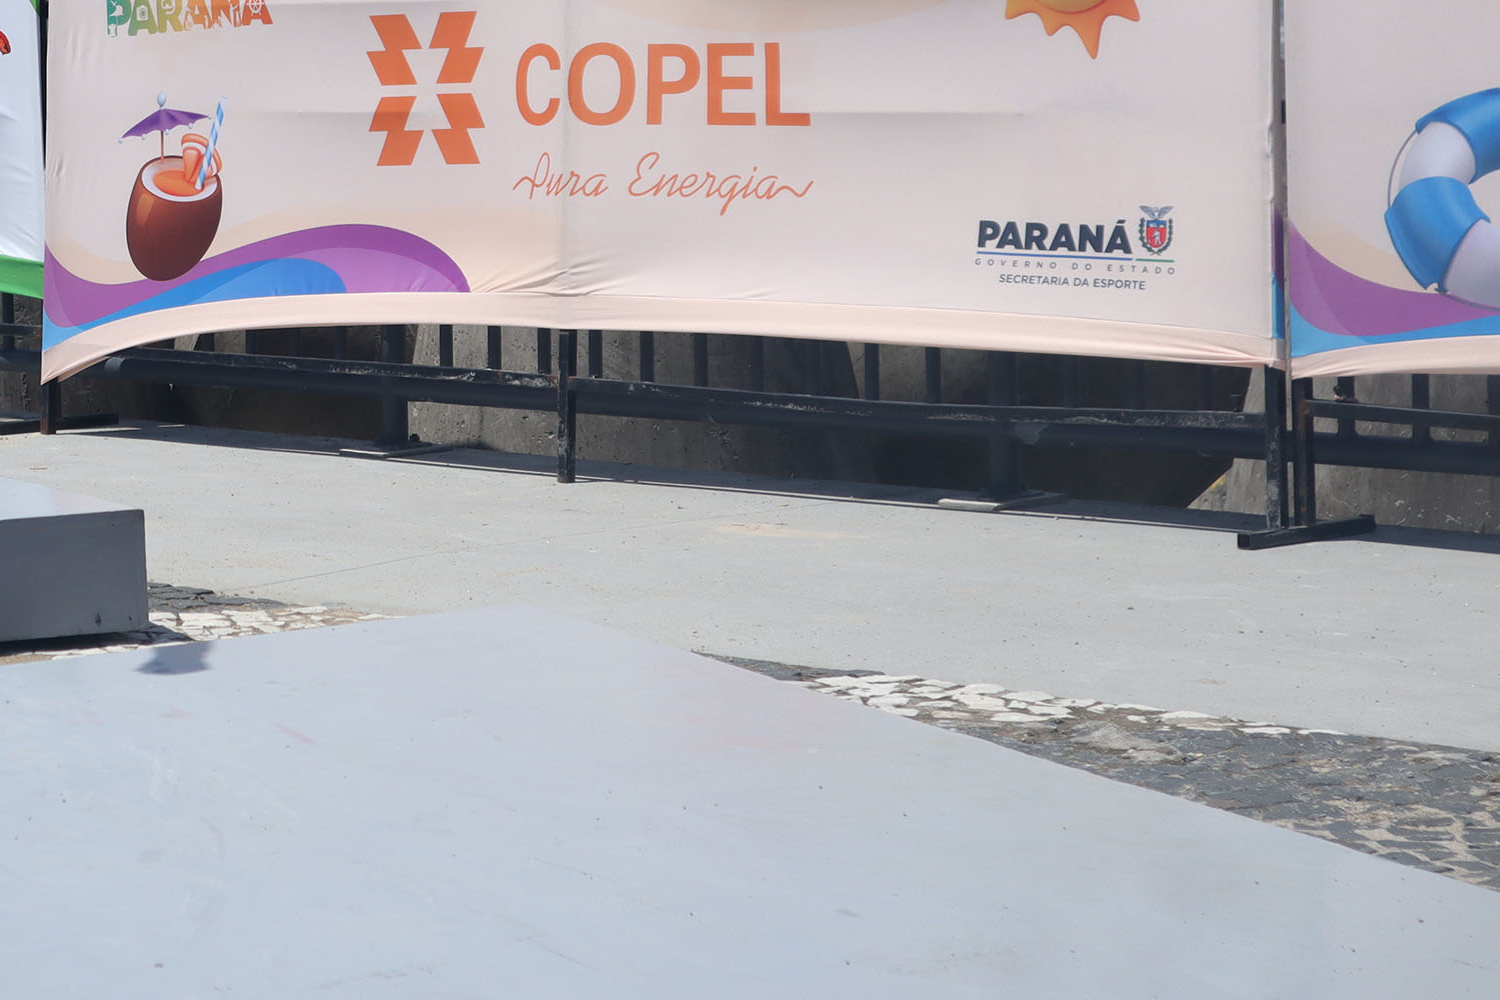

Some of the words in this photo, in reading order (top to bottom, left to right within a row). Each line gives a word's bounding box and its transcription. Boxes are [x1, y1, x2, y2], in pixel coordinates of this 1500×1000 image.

[516, 42, 811, 126] COPEL
[512, 152, 609, 200] Pura
[628, 152, 814, 216] Energia
[977, 219, 1132, 254] PARANÁ
[974, 257, 1058, 270] GOVERNO
[1072, 262, 1093, 272] DO
[1107, 264, 1176, 275] ESTADO
[999, 273, 1070, 287] SECRETARIA
[1073, 277, 1090, 288] DA
[1093, 278, 1147, 290] ESPORTE
